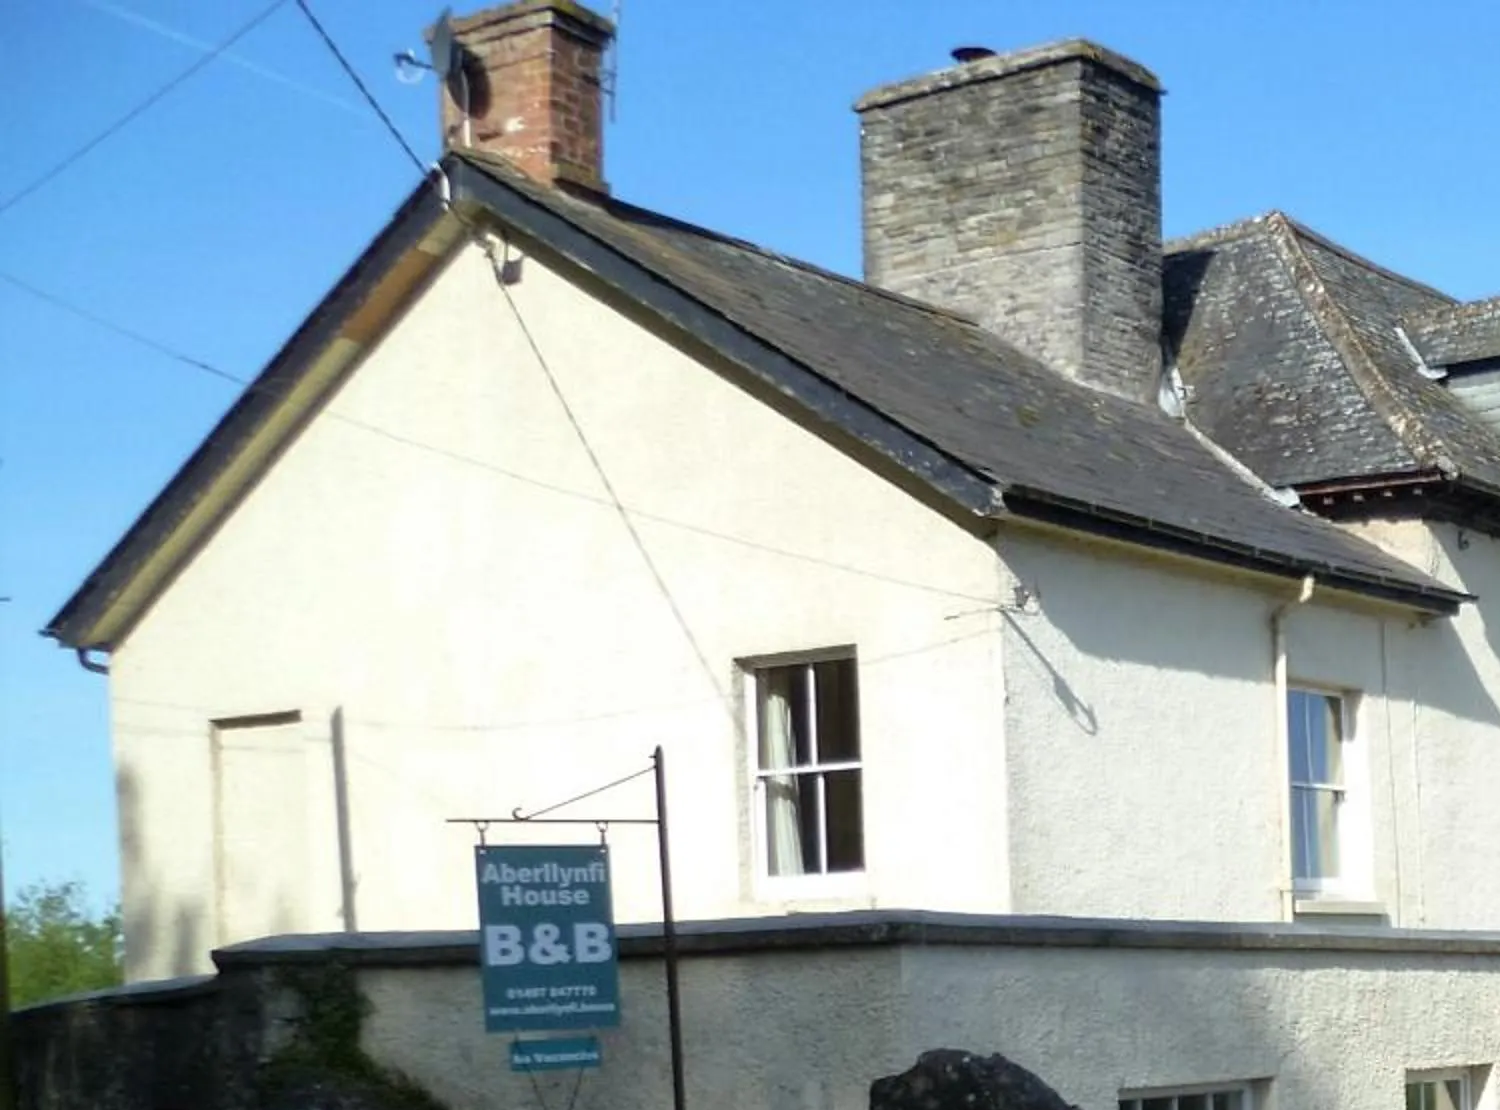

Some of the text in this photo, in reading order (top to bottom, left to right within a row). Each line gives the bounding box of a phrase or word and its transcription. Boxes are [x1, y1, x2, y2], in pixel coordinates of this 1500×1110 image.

[482, 863, 605, 887] Aberllynfi
[501, 885, 590, 906] House
[485, 923, 612, 966] B&B
